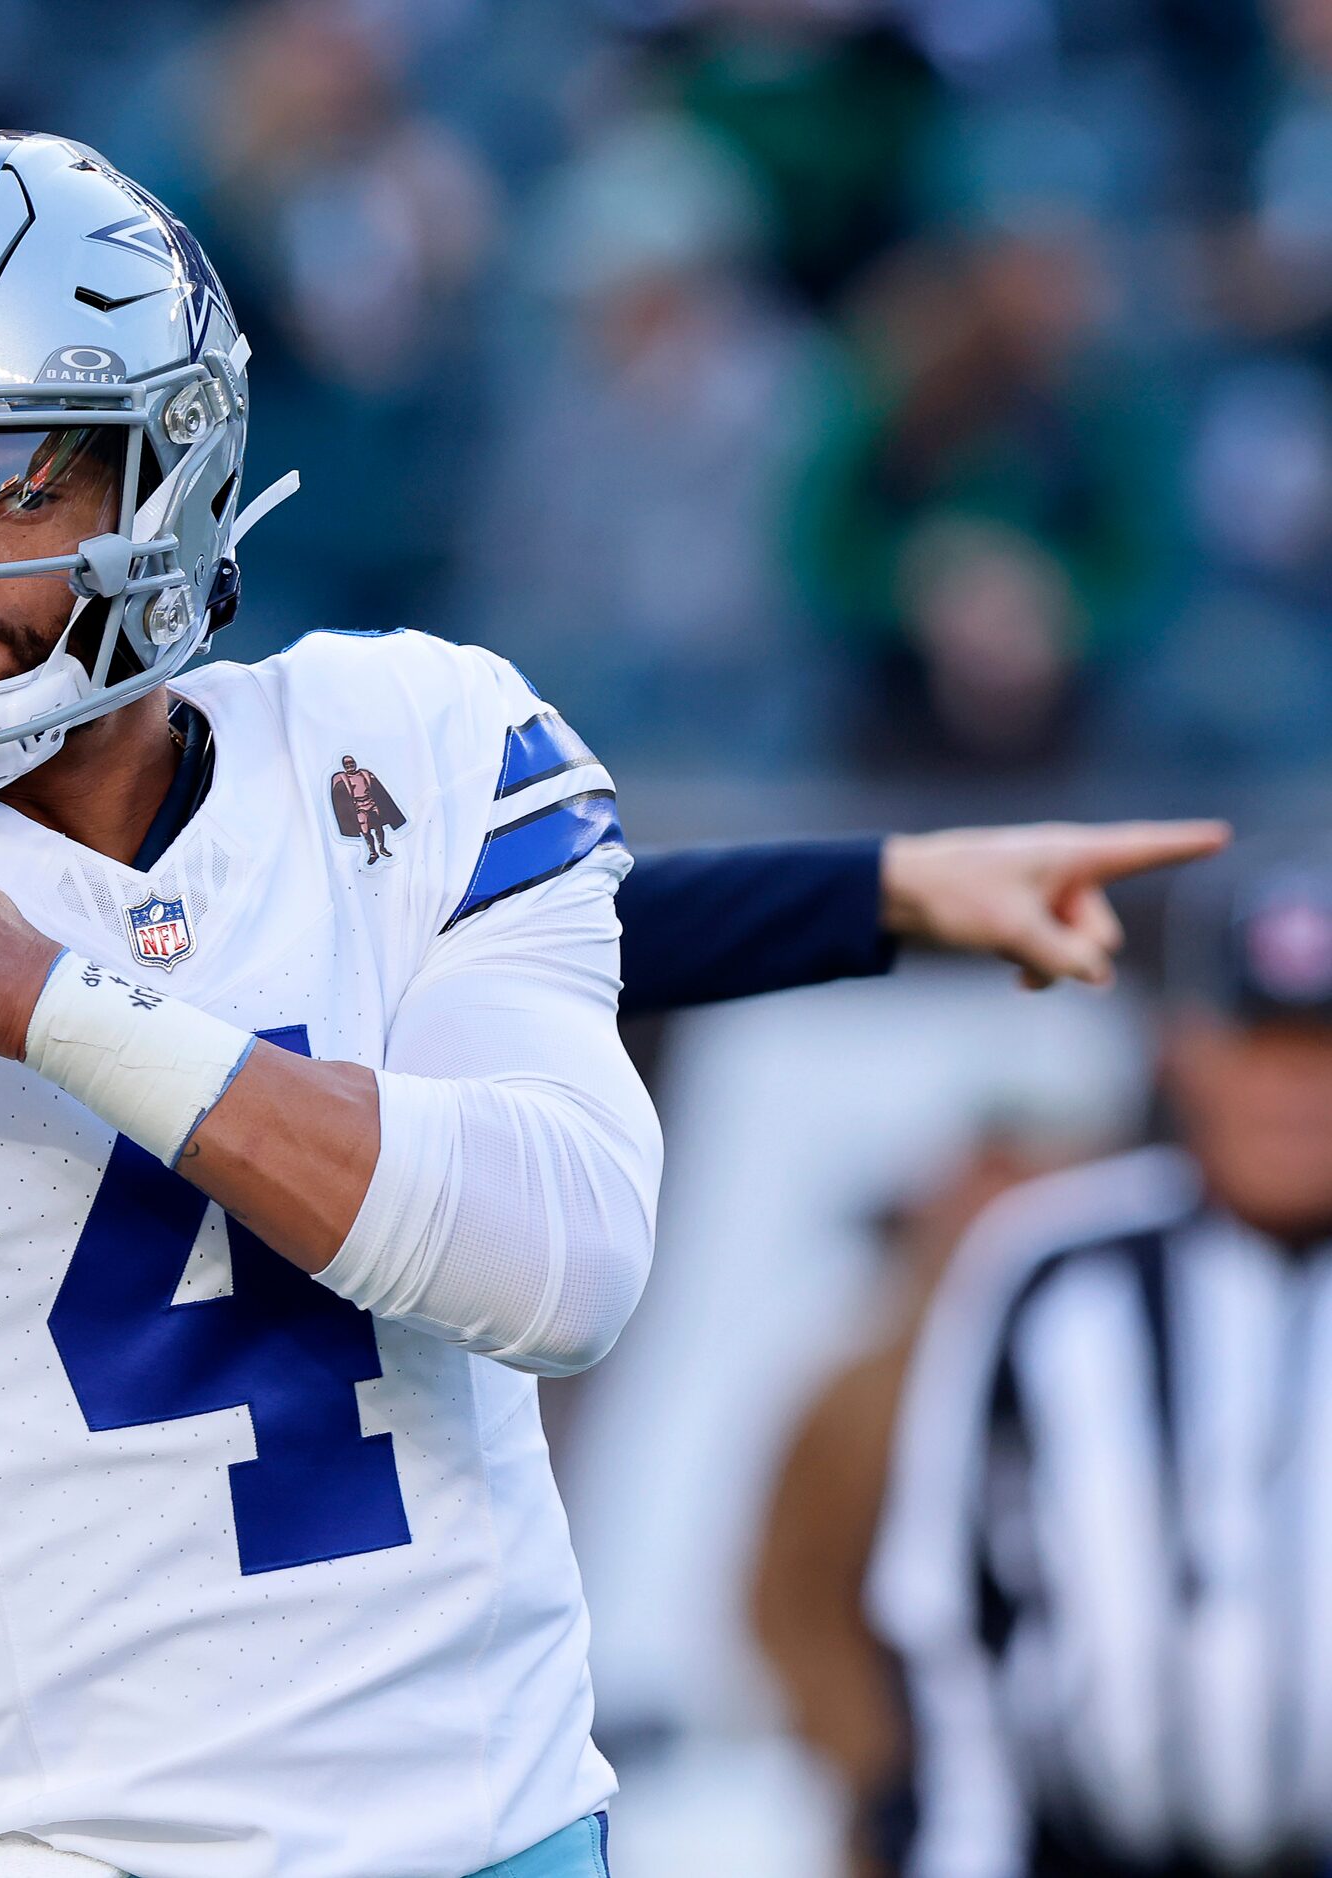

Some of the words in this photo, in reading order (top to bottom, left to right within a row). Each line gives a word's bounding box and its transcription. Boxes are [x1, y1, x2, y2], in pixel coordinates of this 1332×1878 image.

[46, 369, 122, 384] OAKLEY
[138, 923, 187, 956] NFL
[47, 1025, 412, 1576] 4
